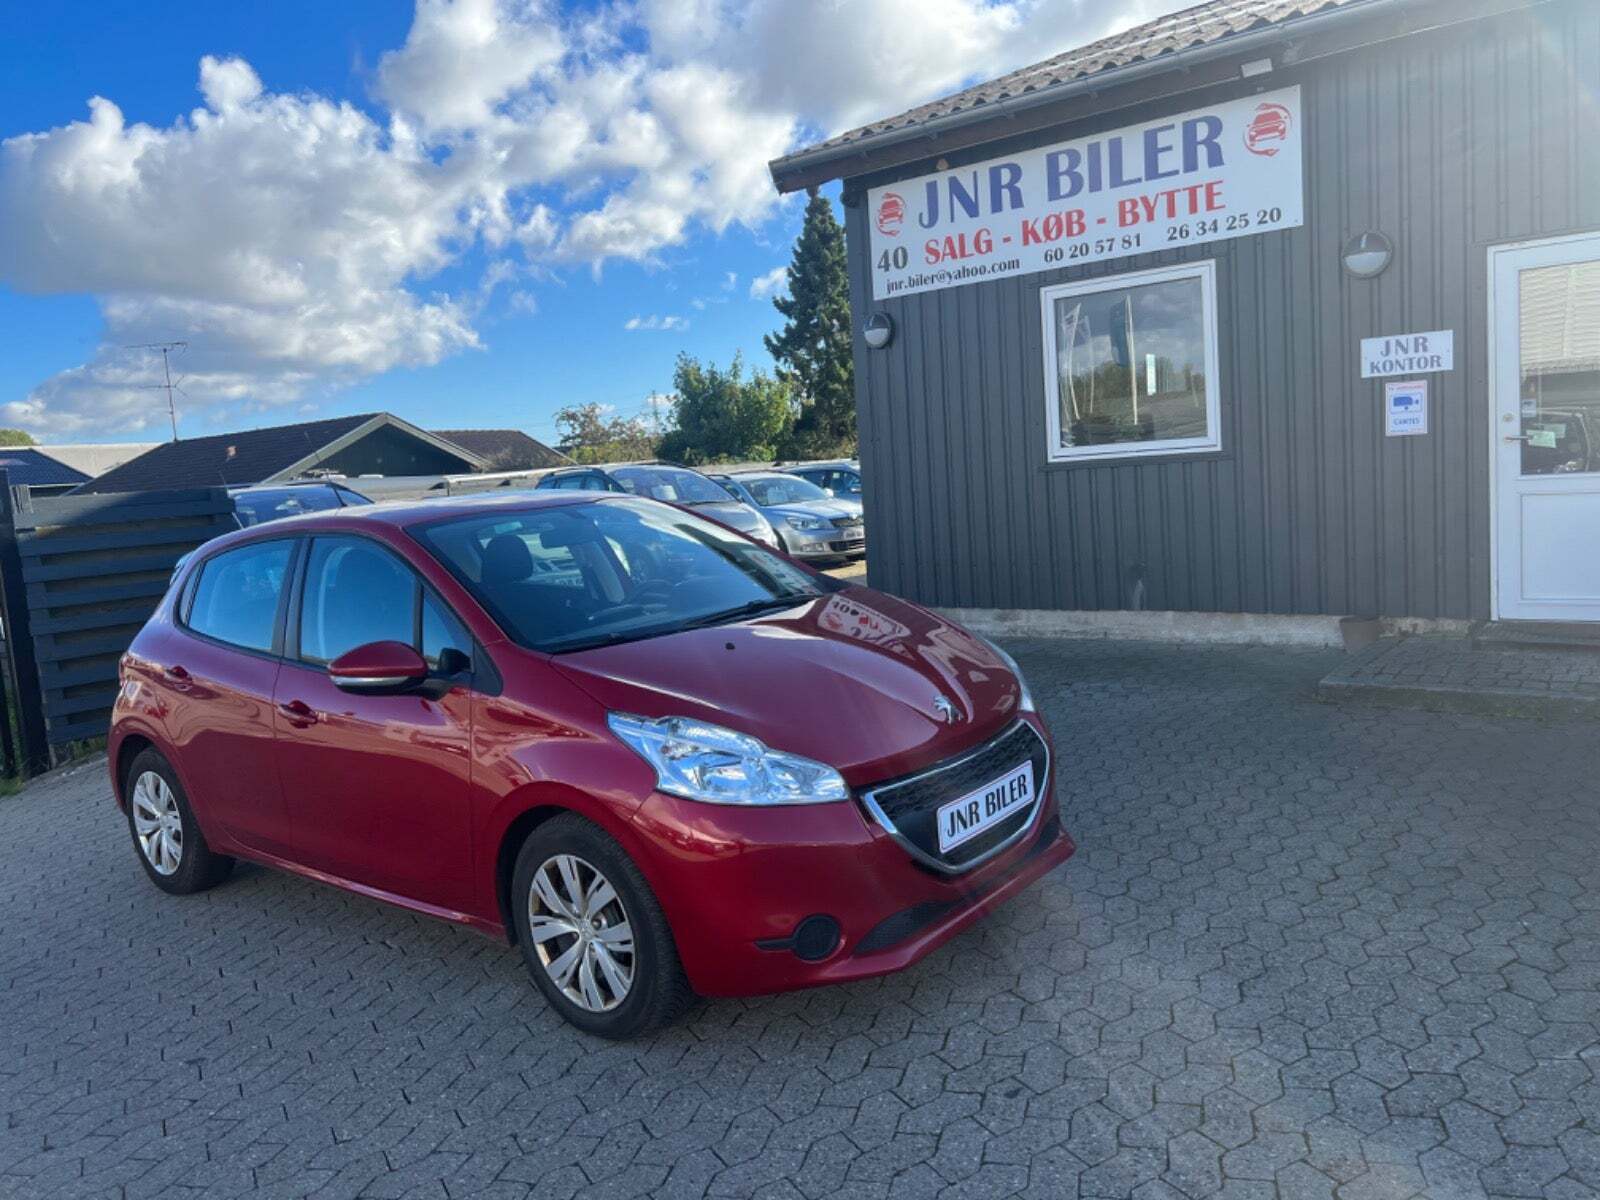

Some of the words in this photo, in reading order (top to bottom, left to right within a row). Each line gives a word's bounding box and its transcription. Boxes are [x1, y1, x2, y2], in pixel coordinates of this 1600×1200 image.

[918, 162, 1024, 229] JNR
[1046, 115, 1225, 202] BILER
[925, 228, 993, 265] SALG
[1002, 236, 1012, 244] -
[1021, 208, 1086, 247] KØB
[1097, 217, 1107, 225] -
[1118, 180, 1226, 228] BYTTE
[1167, 223, 1190, 241] 26
[1196, 219, 1219, 236] 34
[1226, 214, 1249, 232] 25
[1256, 207, 1282, 225] 20
[877, 246, 908, 272] 40
[1044, 246, 1063, 263] 60
[1069, 243, 1090, 259] 20
[1094, 238, 1116, 254] 57
[1121, 233, 1142, 250] 81
[886, 257, 1021, 294] jnr.biler@yahoo.com
[1380, 336, 1429, 356] JNR
[1369, 355, 1442, 374] KONTOR
[947, 800, 981, 838] JNR
[985, 773, 1028, 818] BILER
